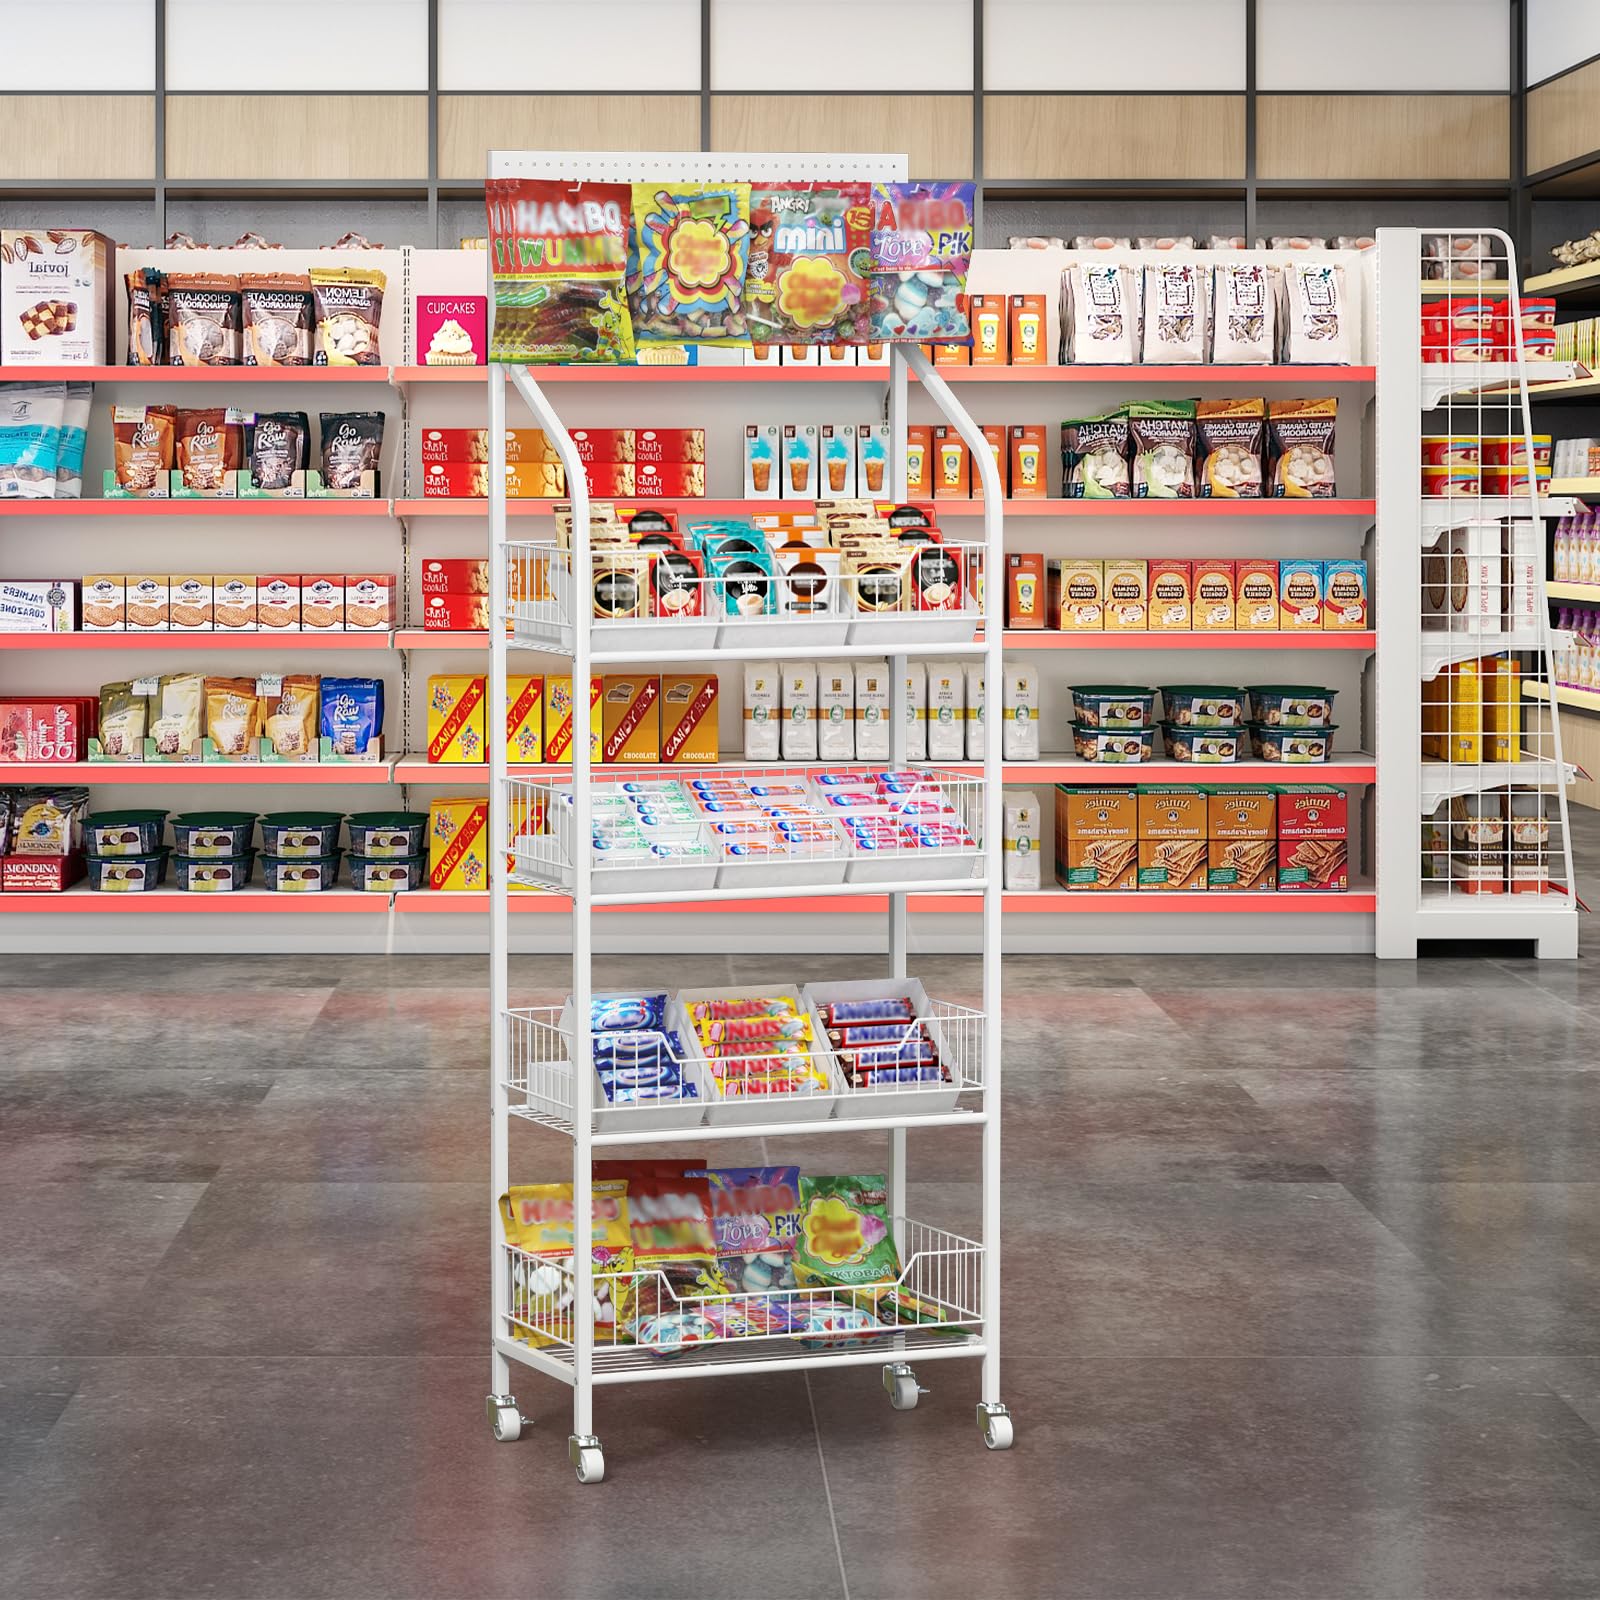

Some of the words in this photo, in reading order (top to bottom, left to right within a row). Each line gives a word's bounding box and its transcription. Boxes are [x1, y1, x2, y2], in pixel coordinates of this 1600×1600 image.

[771, 196, 810, 214] ANGRY
[777, 218, 843, 251] mini
[874, 235, 925, 263] Love
[427, 302, 475, 314] CUPCAKES
[132, 431, 159, 448] Raw
[191, 432, 218, 451] Raw
[258, 432, 286, 449] Raw
[332, 436, 361, 453] Raw
[423, 441, 448, 453] CRISPY
[573, 441, 594, 453] RISPY
[638, 441, 663, 453] CRISPY
[425, 475, 450, 487] CRISPY
[638, 475, 663, 487] CRISPY
[423, 572, 448, 584] CRISPY
[425, 608, 450, 619] CRISPY
[432, 710, 461, 756] CANDY
[550, 721, 572, 756] CAN
[607, 710, 637, 756] CANDY
[666, 710, 696, 756] CANDY
[624, 752, 656, 760] CHOCOLATE
[683, 752, 715, 760] CHOCOLATE
[3, 863, 58, 874] LMONDINA
[434, 836, 464, 884] CANDY
[720, 1221, 763, 1246] Love
